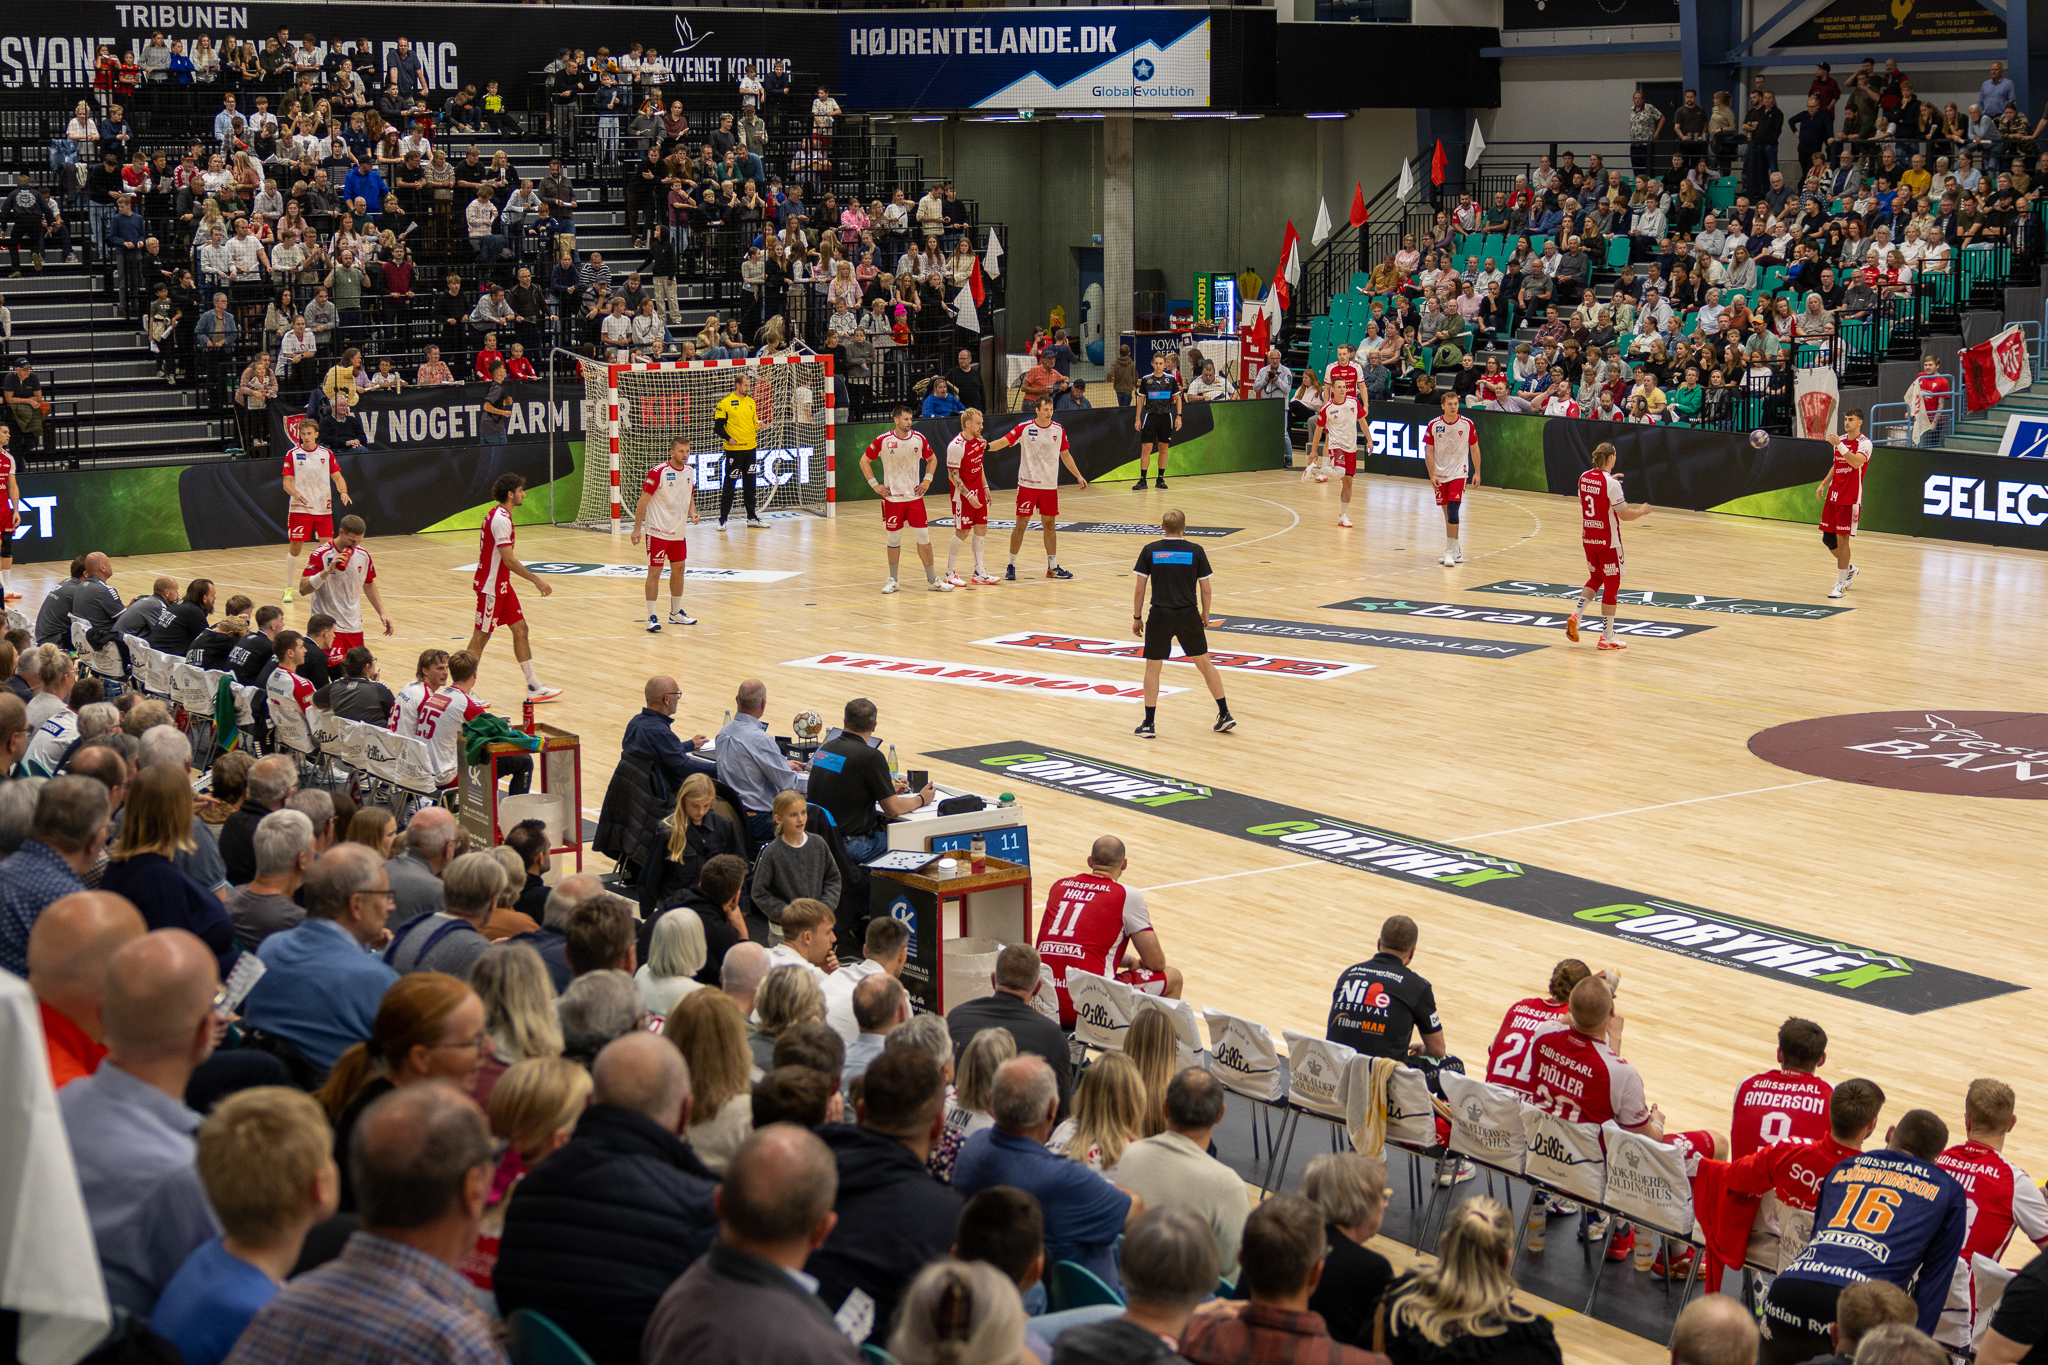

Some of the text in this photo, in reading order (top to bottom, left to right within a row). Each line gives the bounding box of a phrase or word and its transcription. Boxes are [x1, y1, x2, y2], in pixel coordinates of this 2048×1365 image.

[115, 5, 248, 29] TRIBUNEN
[850, 26, 1117, 55] HØJRENTELANDE.DK
[0, 37, 116, 88] SVAN
[1092, 86, 1194, 97] GlobalEvolution
[388, 404, 481, 443] NOGET
[506, 399, 570, 435] ARM
[1584, 495, 1596, 518] 3
[1923, 473, 2048, 527] SELEC
[1231, 623, 1517, 654] AUTOCENTRALEN
[415, 706, 440, 740] 25
[1843, 738, 2048, 786] BAN
[979, 753, 1209, 807] CORYHEX
[1001, 833, 1020, 851] 11
[1246, 821, 1521, 888] CORYHEX
[1060, 879, 1111, 892] SWISSPEARL
[1048, 901, 1085, 937] 11
[1042, 943, 1083, 956] BYGMA
[1573, 904, 1912, 989] CORYHEX
[1078, 1003, 1126, 1030] lillis
[1333, 1002, 1388, 1018] FESTIVAL
[1514, 1004, 1565, 1021] SWISSPEAR
[1214, 1043, 1272, 1074] lillis
[1493, 1031, 1535, 1083] 21
[1540, 1044, 1593, 1078] SWISSPEARL
[1537, 1061, 1584, 1098] MÖLLER
[1753, 1079, 1821, 1094] SWISSPEARL
[1743, 1091, 1825, 1115] ANDERSON
[1529, 1133, 1590, 1166] lillis
[1832, 1164, 1941, 1201] BJÖRGVINSSON
[1934, 1155, 2000, 1179] WISSPEARL
[1828, 1184, 1902, 1234] 16
[1821, 1232, 1886, 1258] BYGMA
[1803, 1260, 1872, 1284] Udviklin
[1764, 1301, 1833, 1336] ristian Ryt
